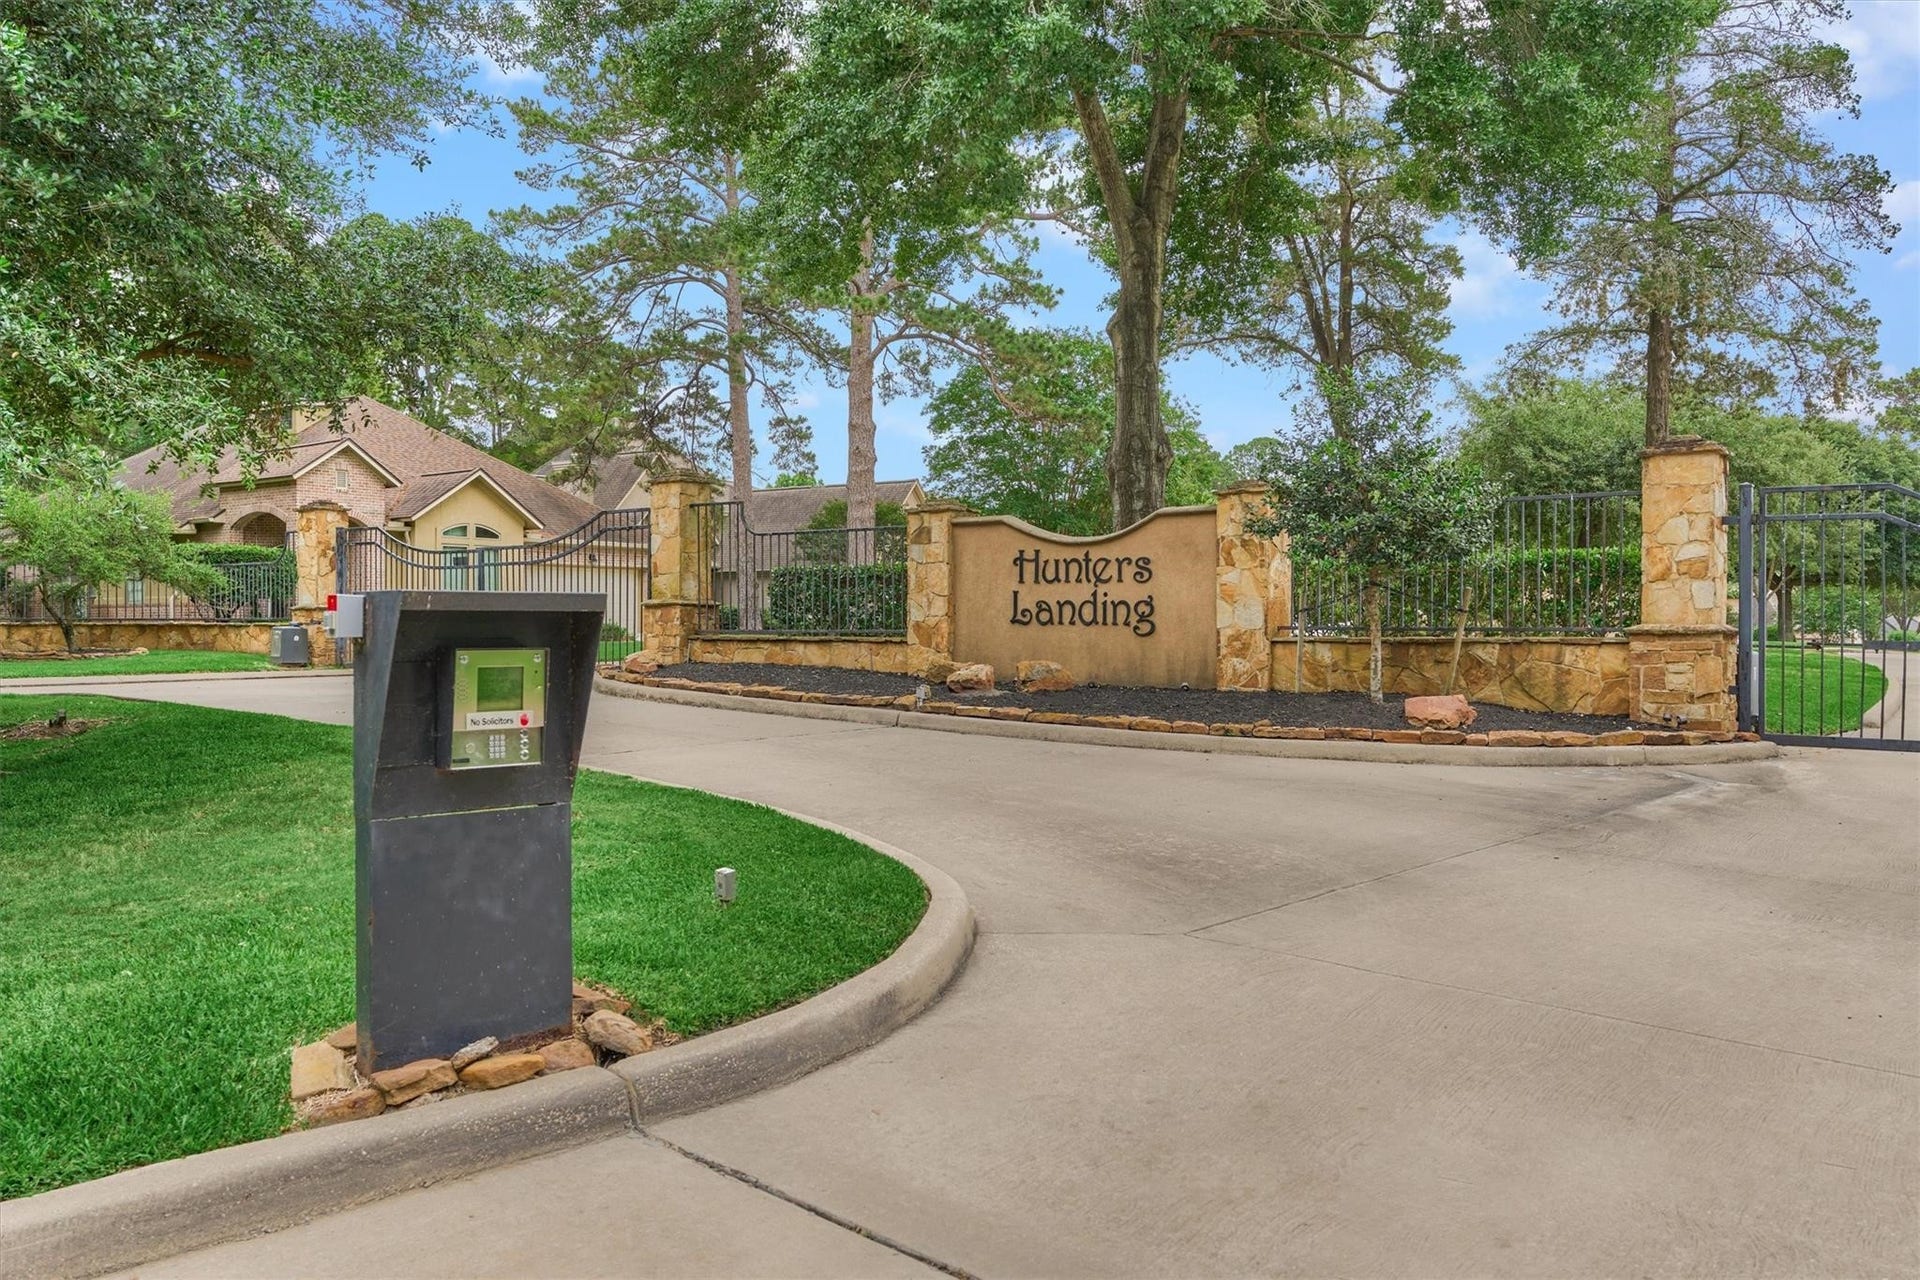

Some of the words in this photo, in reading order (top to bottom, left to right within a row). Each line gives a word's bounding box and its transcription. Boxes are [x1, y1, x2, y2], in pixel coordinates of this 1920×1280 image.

[1013, 549, 1153, 587] Hunters
[1010, 589, 1156, 637] Landing
[470, 718, 480, 726] No
[481, 717, 514, 726] Solicitors
